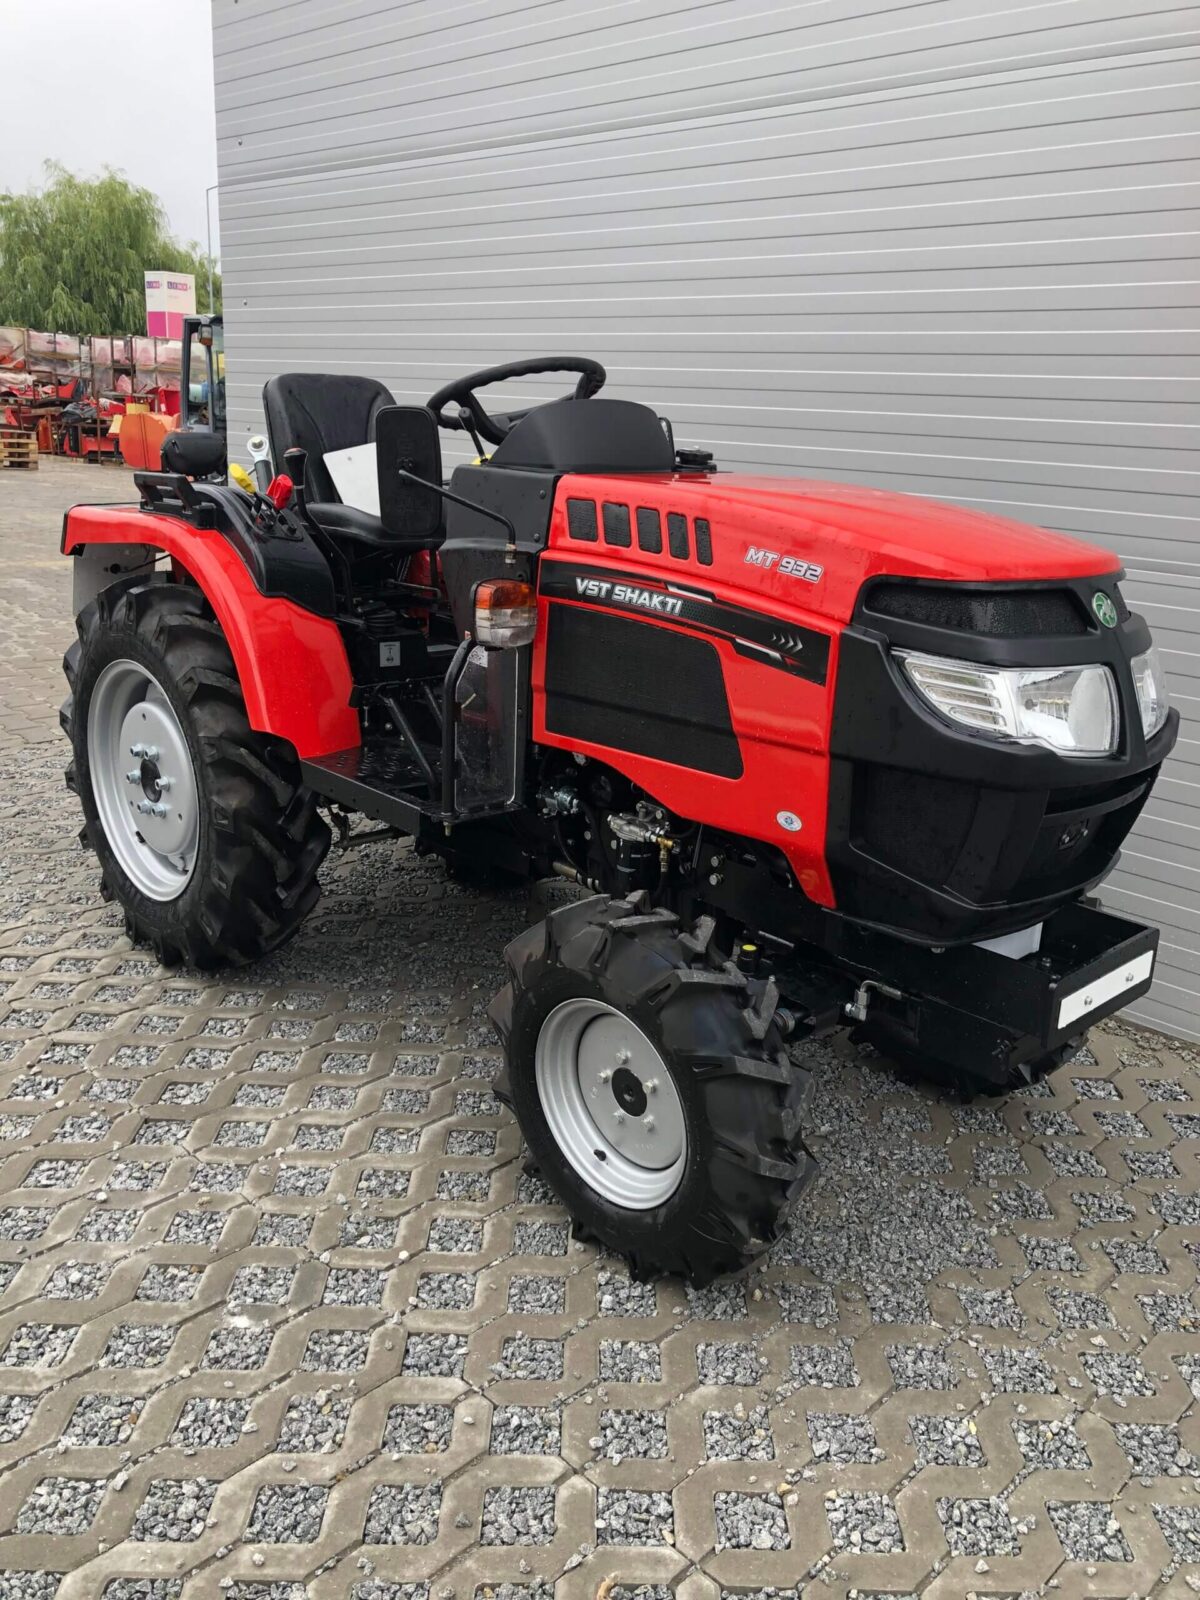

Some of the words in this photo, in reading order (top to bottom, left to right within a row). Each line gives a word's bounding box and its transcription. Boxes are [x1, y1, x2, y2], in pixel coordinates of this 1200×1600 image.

[745, 547, 779, 568] MT
[778, 556, 823, 583] 932
[575, 577, 611, 599] VST
[611, 584, 683, 616] SHAKTI
